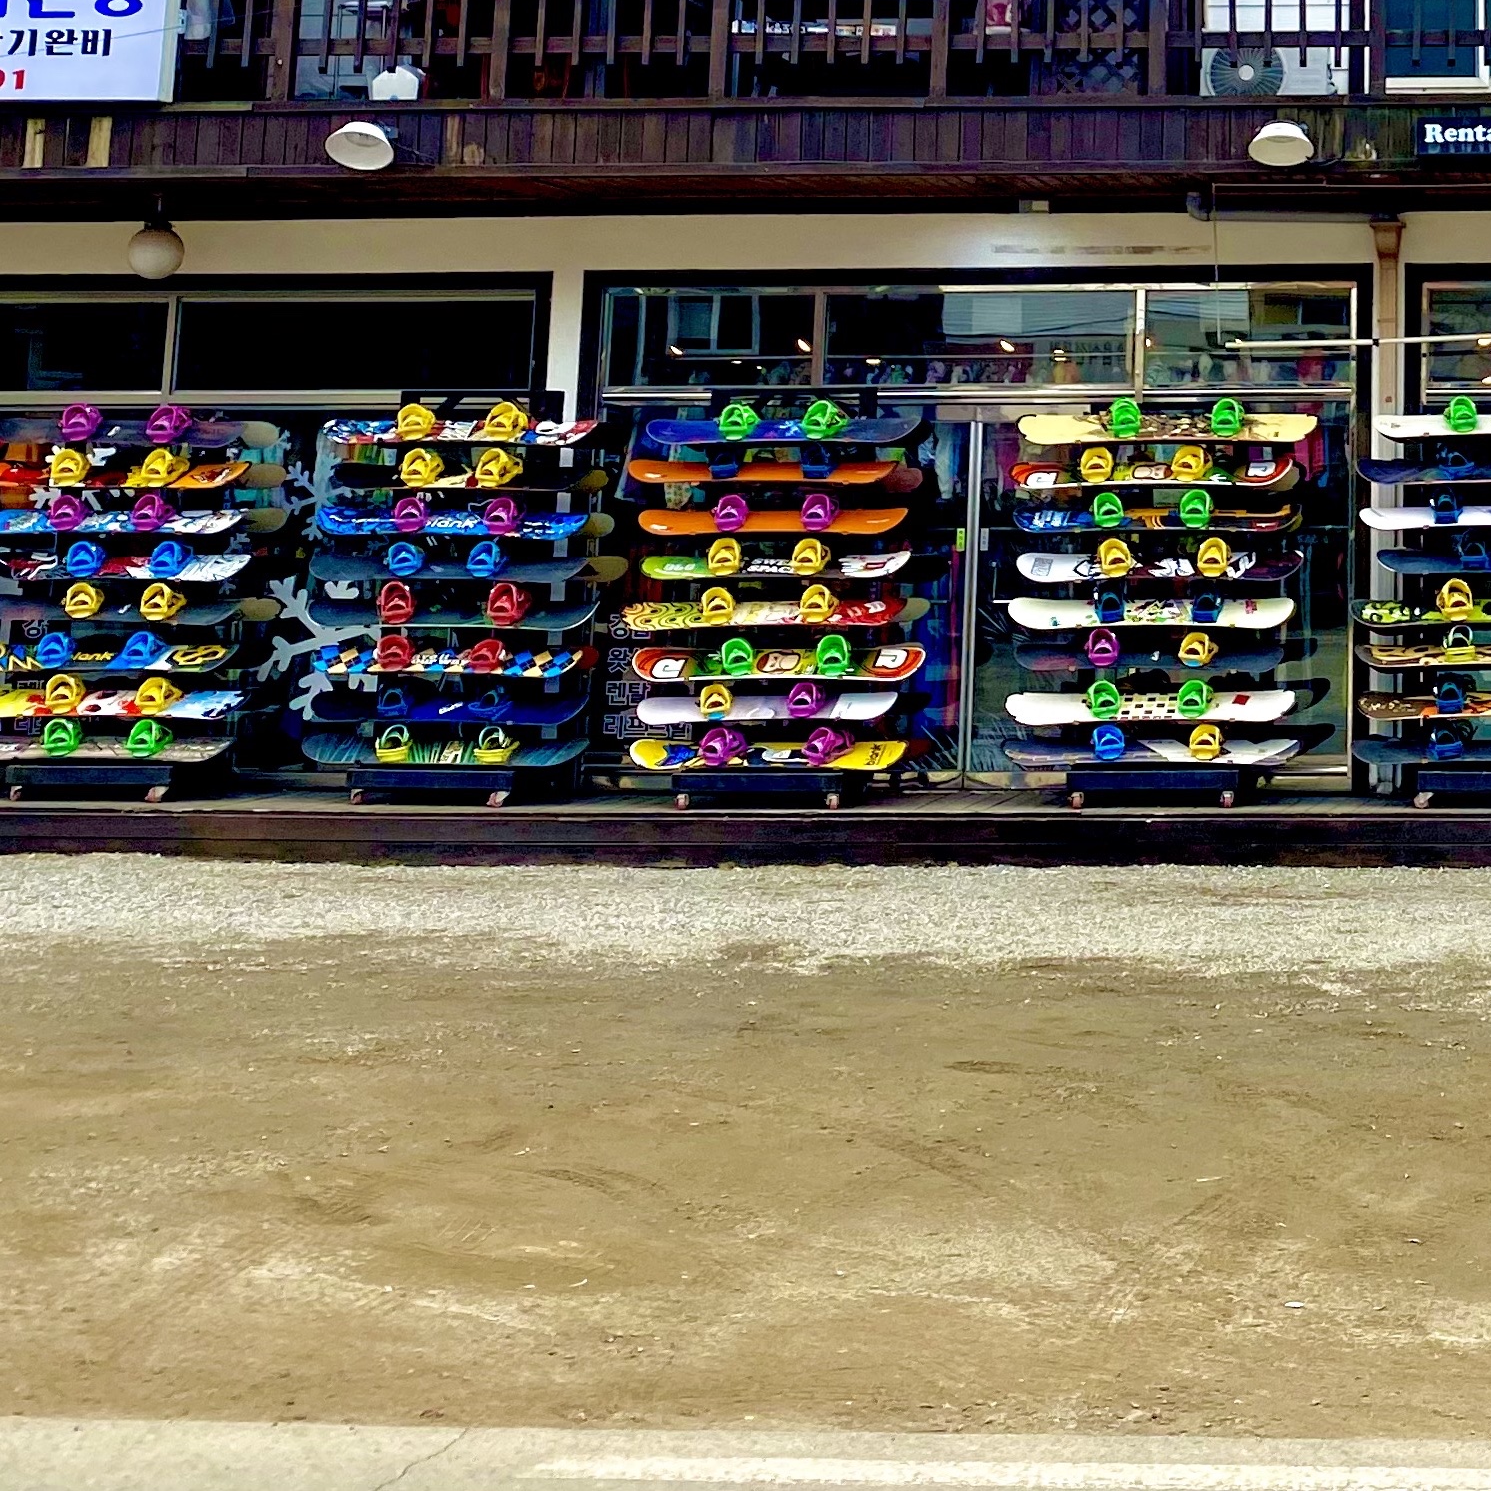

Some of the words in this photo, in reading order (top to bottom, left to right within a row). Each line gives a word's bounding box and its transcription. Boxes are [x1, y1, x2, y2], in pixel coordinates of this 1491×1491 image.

[0, 28, 112, 56] 기완비
[426, 518, 479, 529] lank
[72, 651, 115, 661] lank
